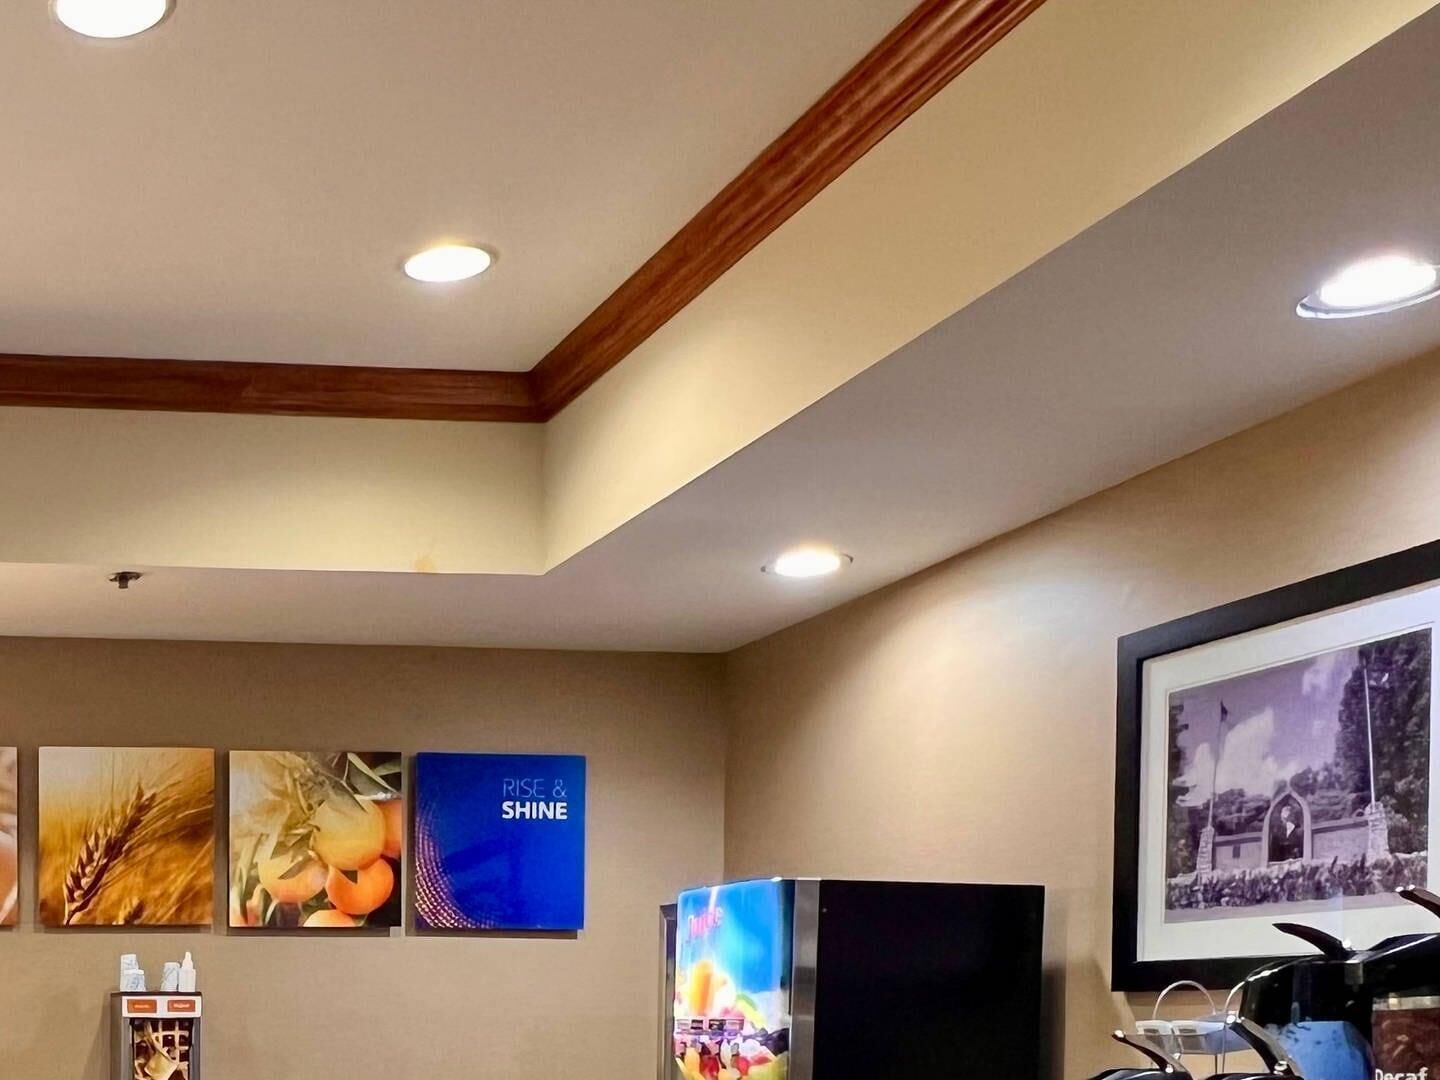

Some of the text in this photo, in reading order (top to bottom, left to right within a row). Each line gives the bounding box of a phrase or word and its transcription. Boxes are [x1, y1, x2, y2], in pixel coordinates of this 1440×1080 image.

[503, 777, 568, 798] RISE &
[501, 800, 568, 820] SHINE
